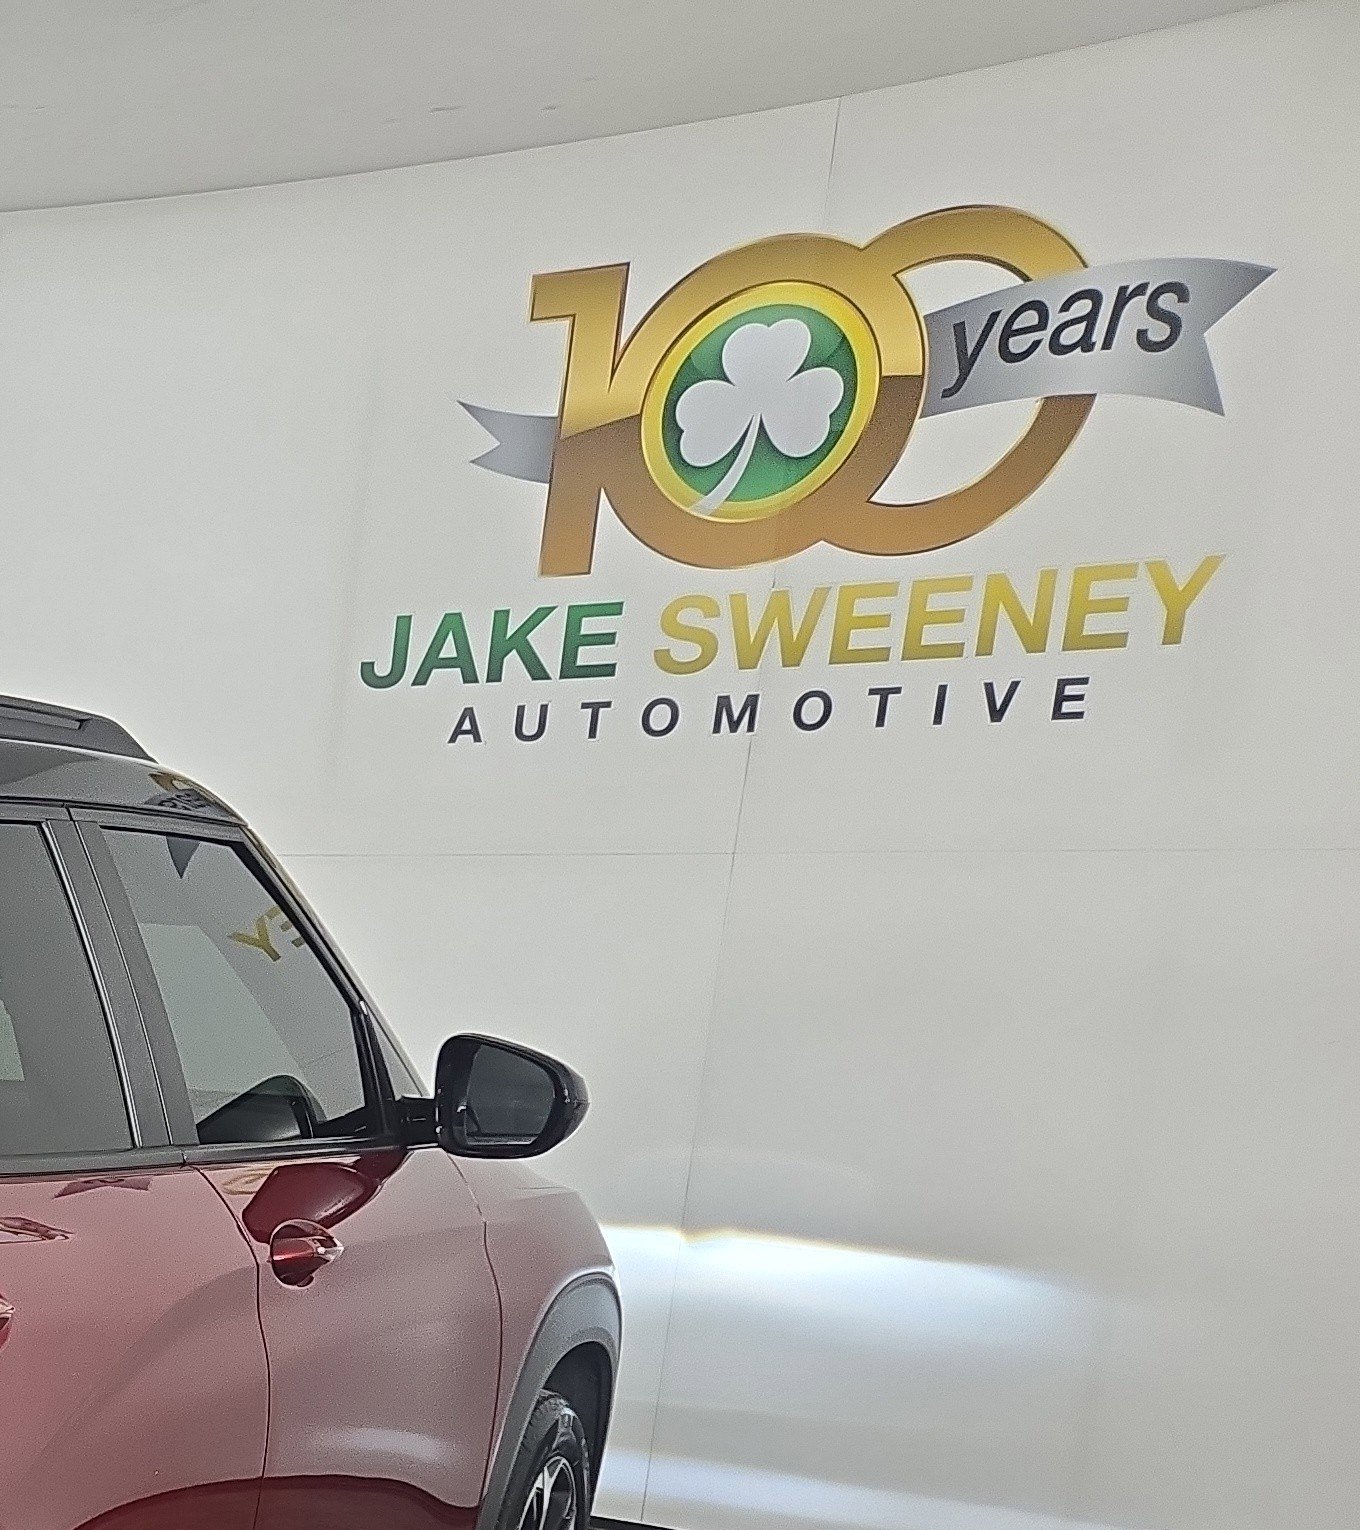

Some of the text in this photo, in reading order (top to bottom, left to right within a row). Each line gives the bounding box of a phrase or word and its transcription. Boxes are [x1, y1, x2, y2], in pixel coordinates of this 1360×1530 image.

[941, 279, 1190, 400] years
[359, 553, 1226, 690] JAKE SWEENEY
[447, 675, 1090, 745] AUTOMOTIVE
